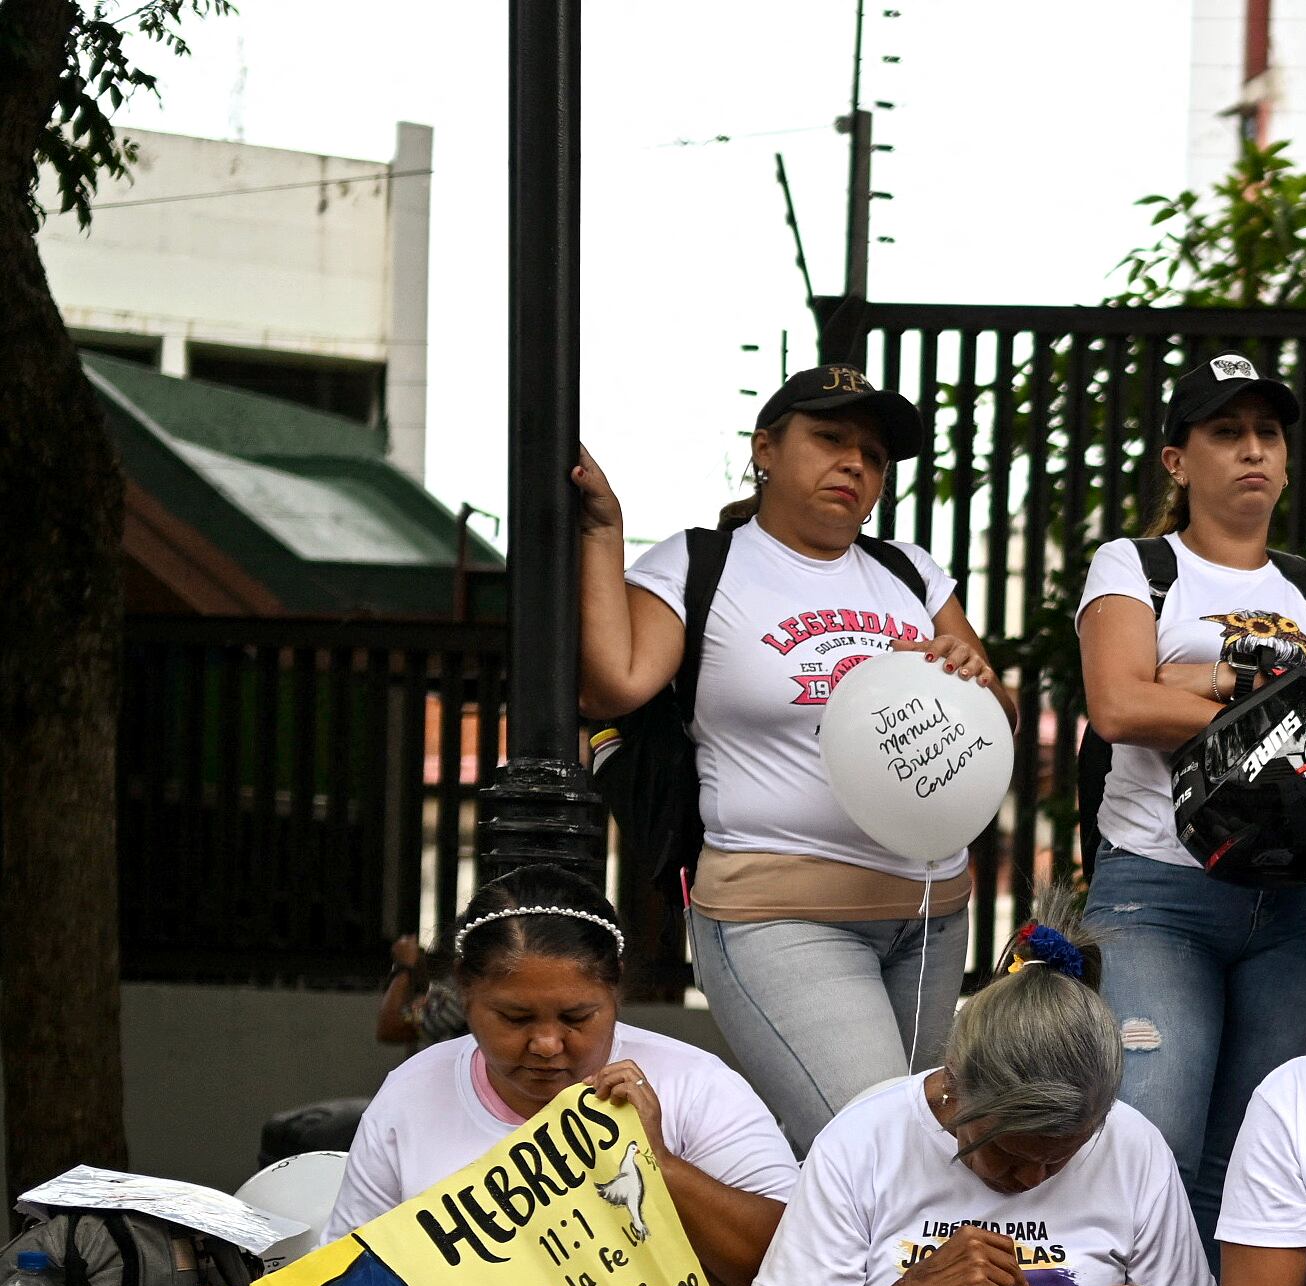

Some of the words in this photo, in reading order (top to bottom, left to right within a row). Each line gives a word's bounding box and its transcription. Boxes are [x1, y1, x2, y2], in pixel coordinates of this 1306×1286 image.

[760, 608, 930, 657] LEGENDAR
[814, 635, 857, 656] GOLDEN
[860, 637, 892, 652] STAT
[799, 662, 829, 673] EST.
[807, 680, 831, 700] 19
[871, 697, 925, 736] Juan
[1241, 710, 1303, 783] SURE
[914, 735, 994, 799] Cordova
[415, 1087, 620, 1267] HEBREOS
[539, 1208, 595, 1266] 11:1
[1006, 1221, 1050, 1241] PARA
[1016, 1244, 1067, 1265] LAS
